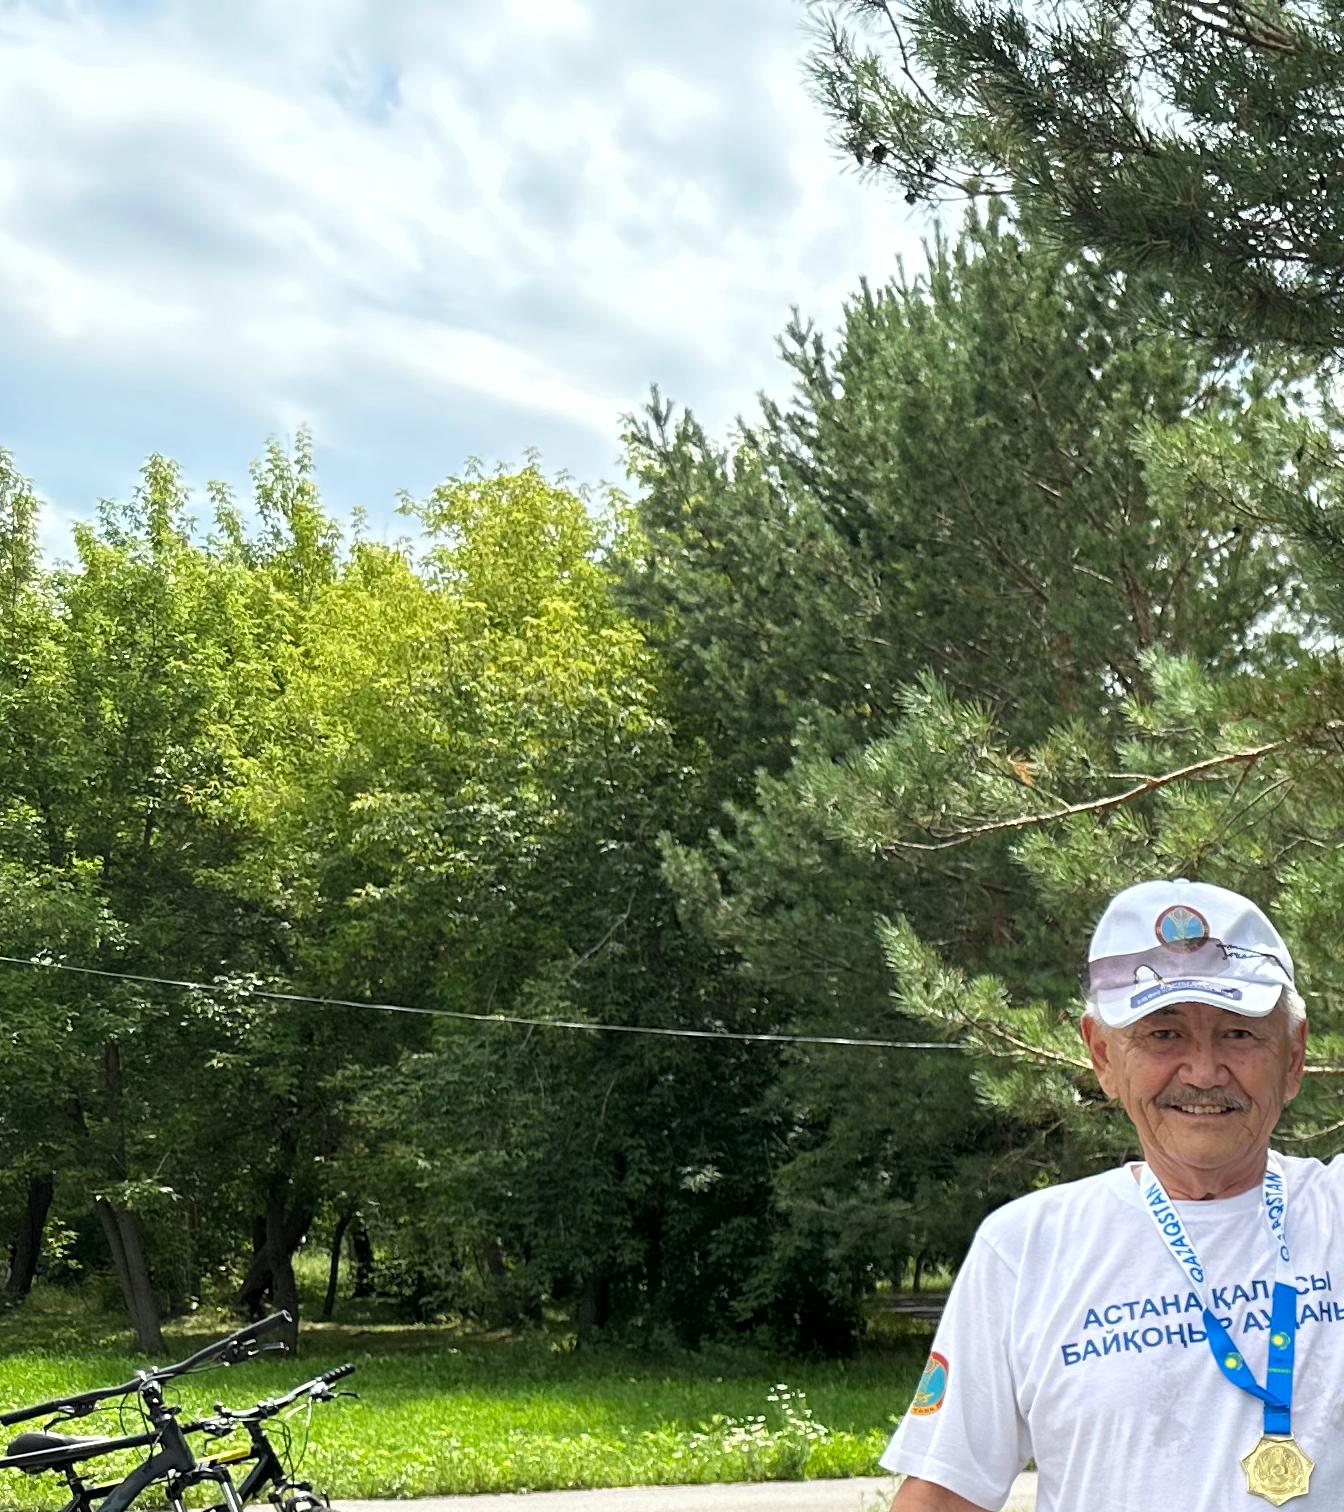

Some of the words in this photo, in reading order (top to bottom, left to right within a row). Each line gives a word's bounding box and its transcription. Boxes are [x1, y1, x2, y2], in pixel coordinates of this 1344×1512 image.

[1144, 1182, 1205, 1284] QAZAQSTAN
[1082, 1291, 1204, 1330] АСТАНА
[1211, 1270, 1333, 1311] ҚАЛСЫ
